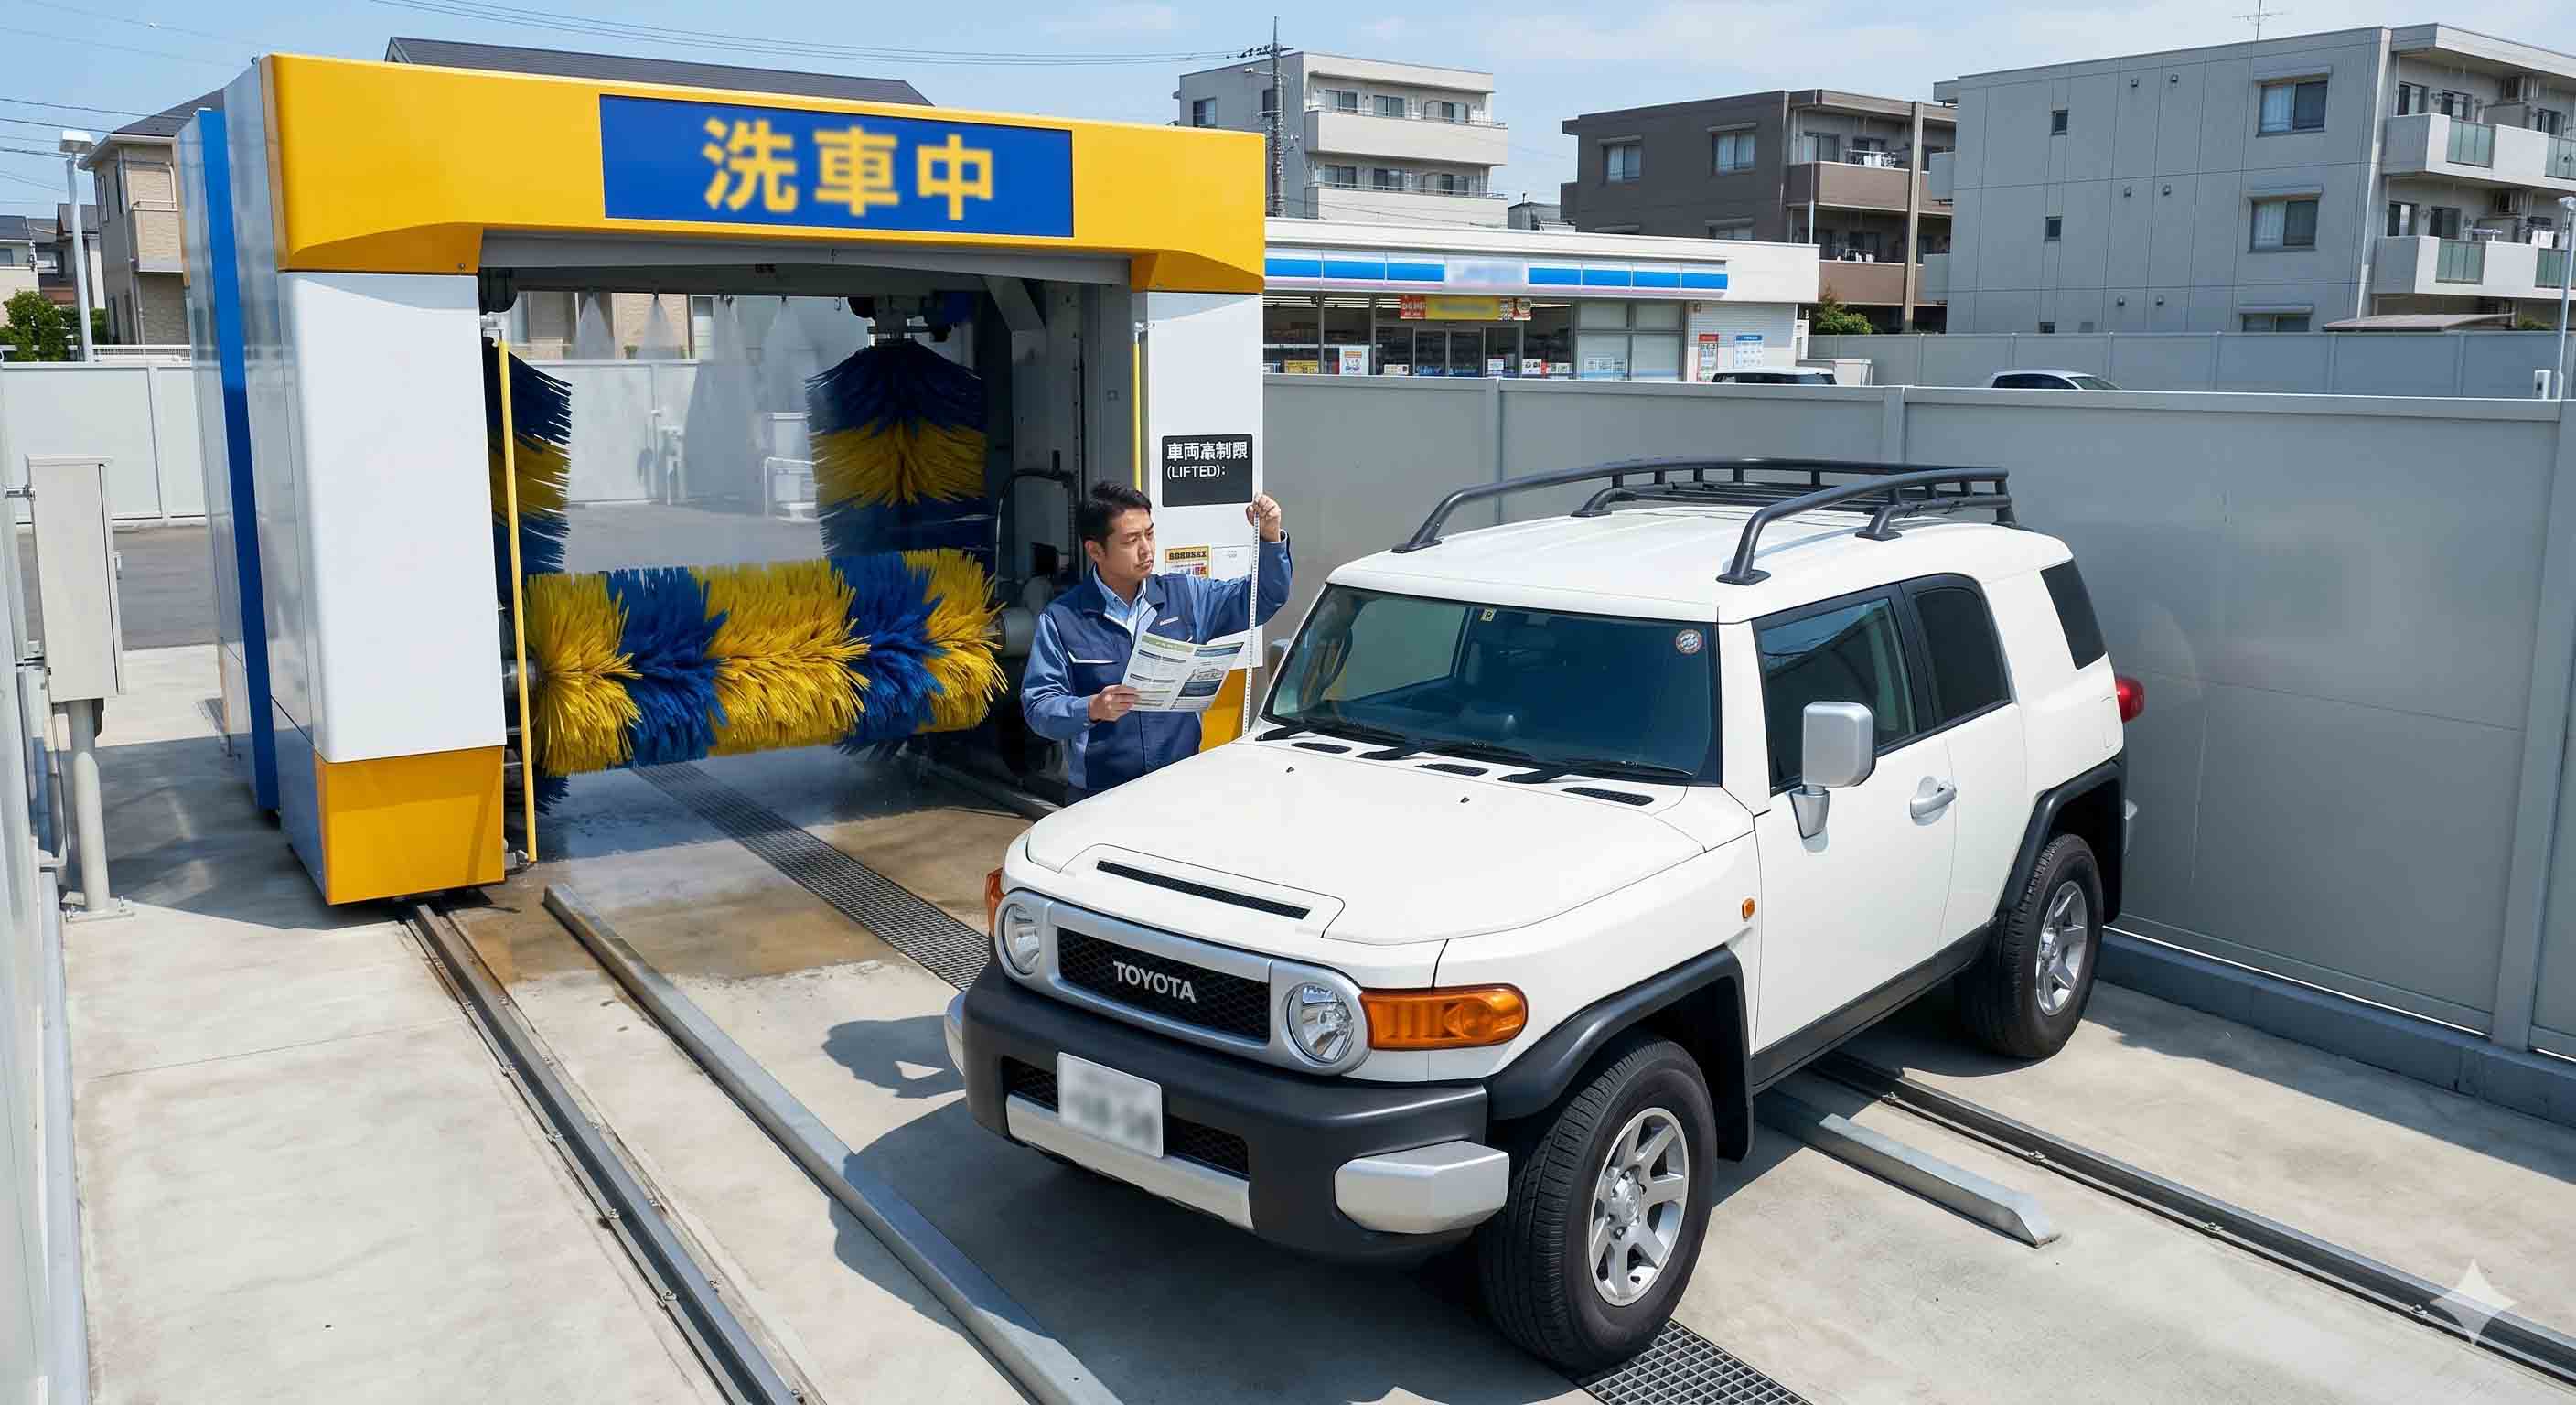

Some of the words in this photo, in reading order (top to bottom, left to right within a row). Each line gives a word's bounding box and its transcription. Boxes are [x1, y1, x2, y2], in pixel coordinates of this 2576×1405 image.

[703, 117, 993, 220] 洗車中
[1167, 464, 1225, 479] (LIFTED):
[1113, 960, 1197, 1003] TOYOTA
